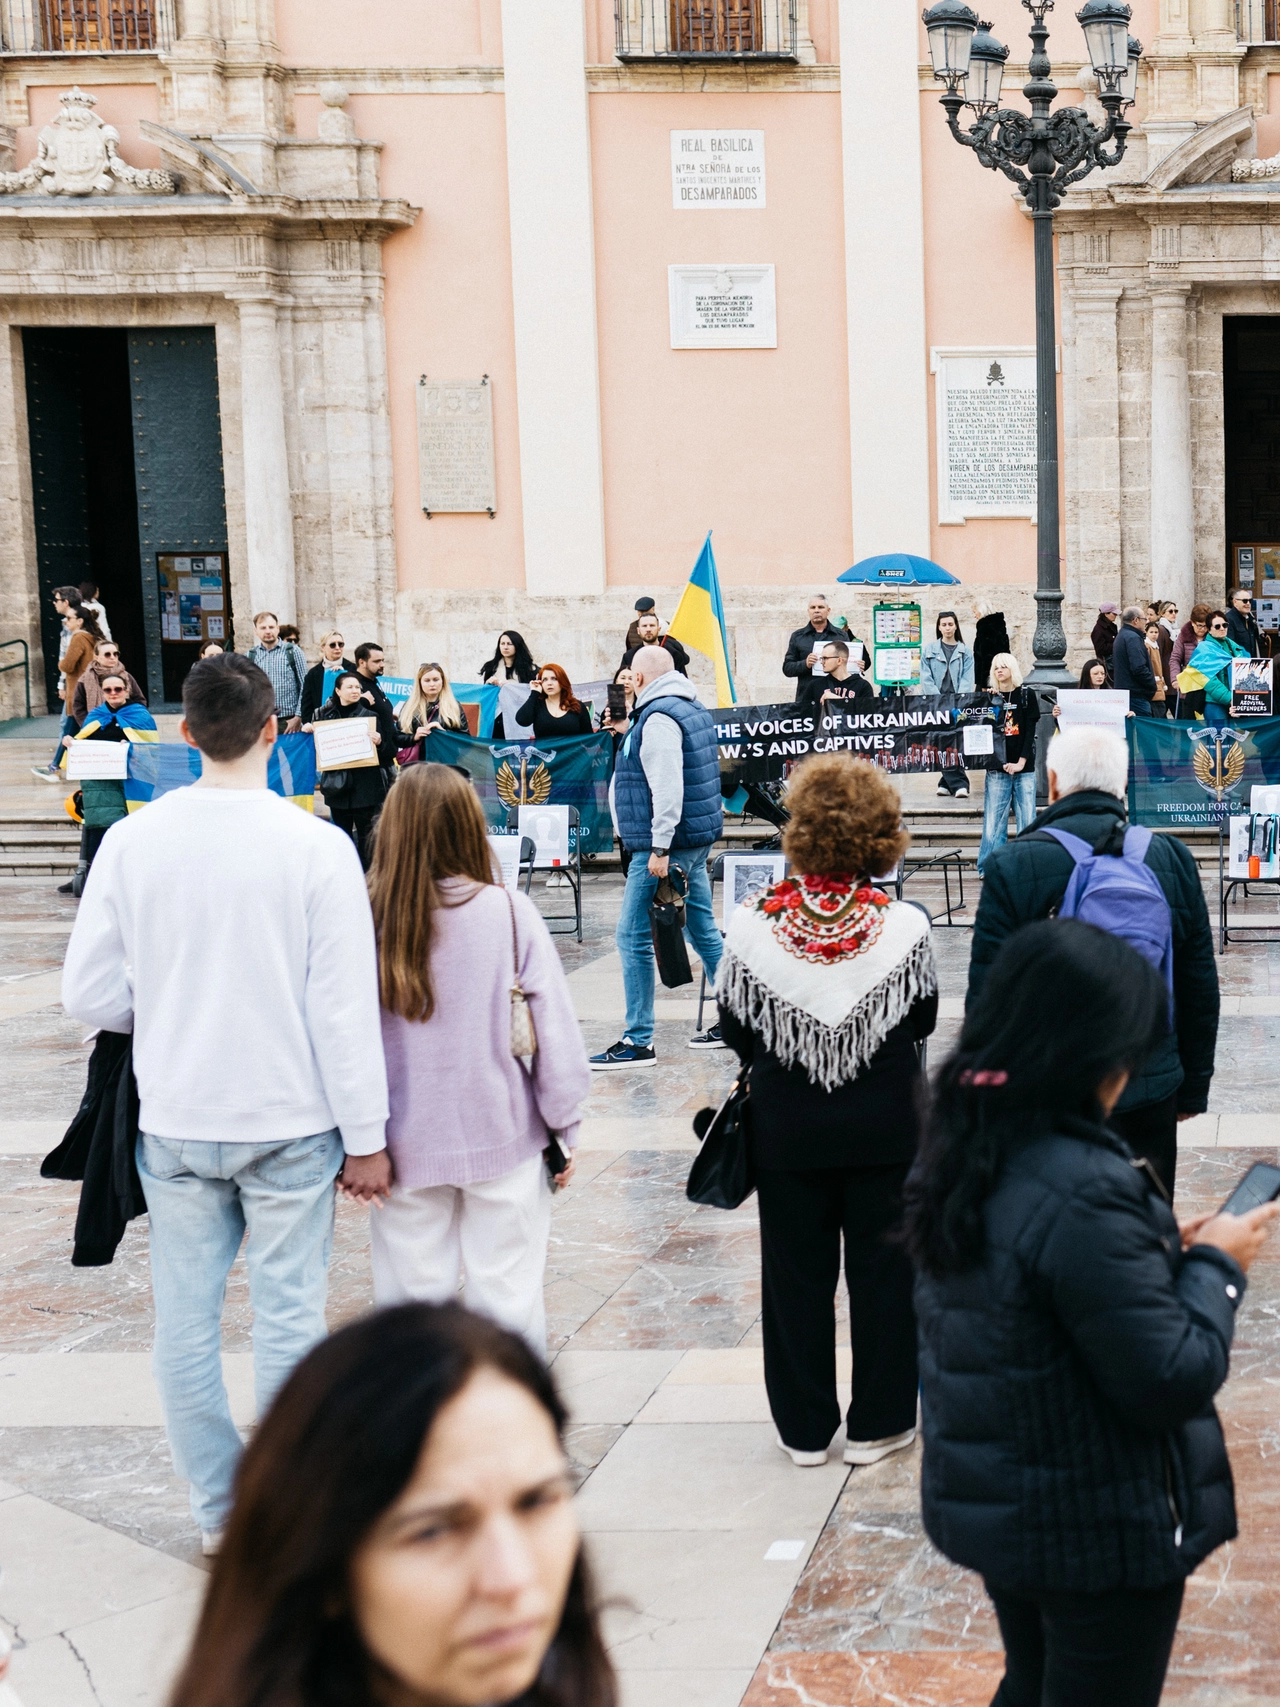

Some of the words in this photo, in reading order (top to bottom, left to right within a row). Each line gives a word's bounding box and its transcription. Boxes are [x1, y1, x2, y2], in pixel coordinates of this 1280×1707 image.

[682, 139, 706, 152] REAL
[711, 138, 754, 152] BASILICA
[700, 162, 731, 173] SEÑORA
[681, 187, 757, 200] DESAMPARADOS
[958, 706, 994, 715] VOICES
[714, 724, 741, 738] HE
[744, 718, 814, 736] VOICES
[822, 715, 842, 731] OF
[846, 710, 950, 729] UKRAINIAN
[768, 739, 809, 756] AND
[813, 734, 895, 752] CAPTIVES
[1157, 803, 1205, 812] FREEDOM
[1208, 803, 1228, 811] FOR
[1171, 814, 1224, 822] UKRAINIAN
